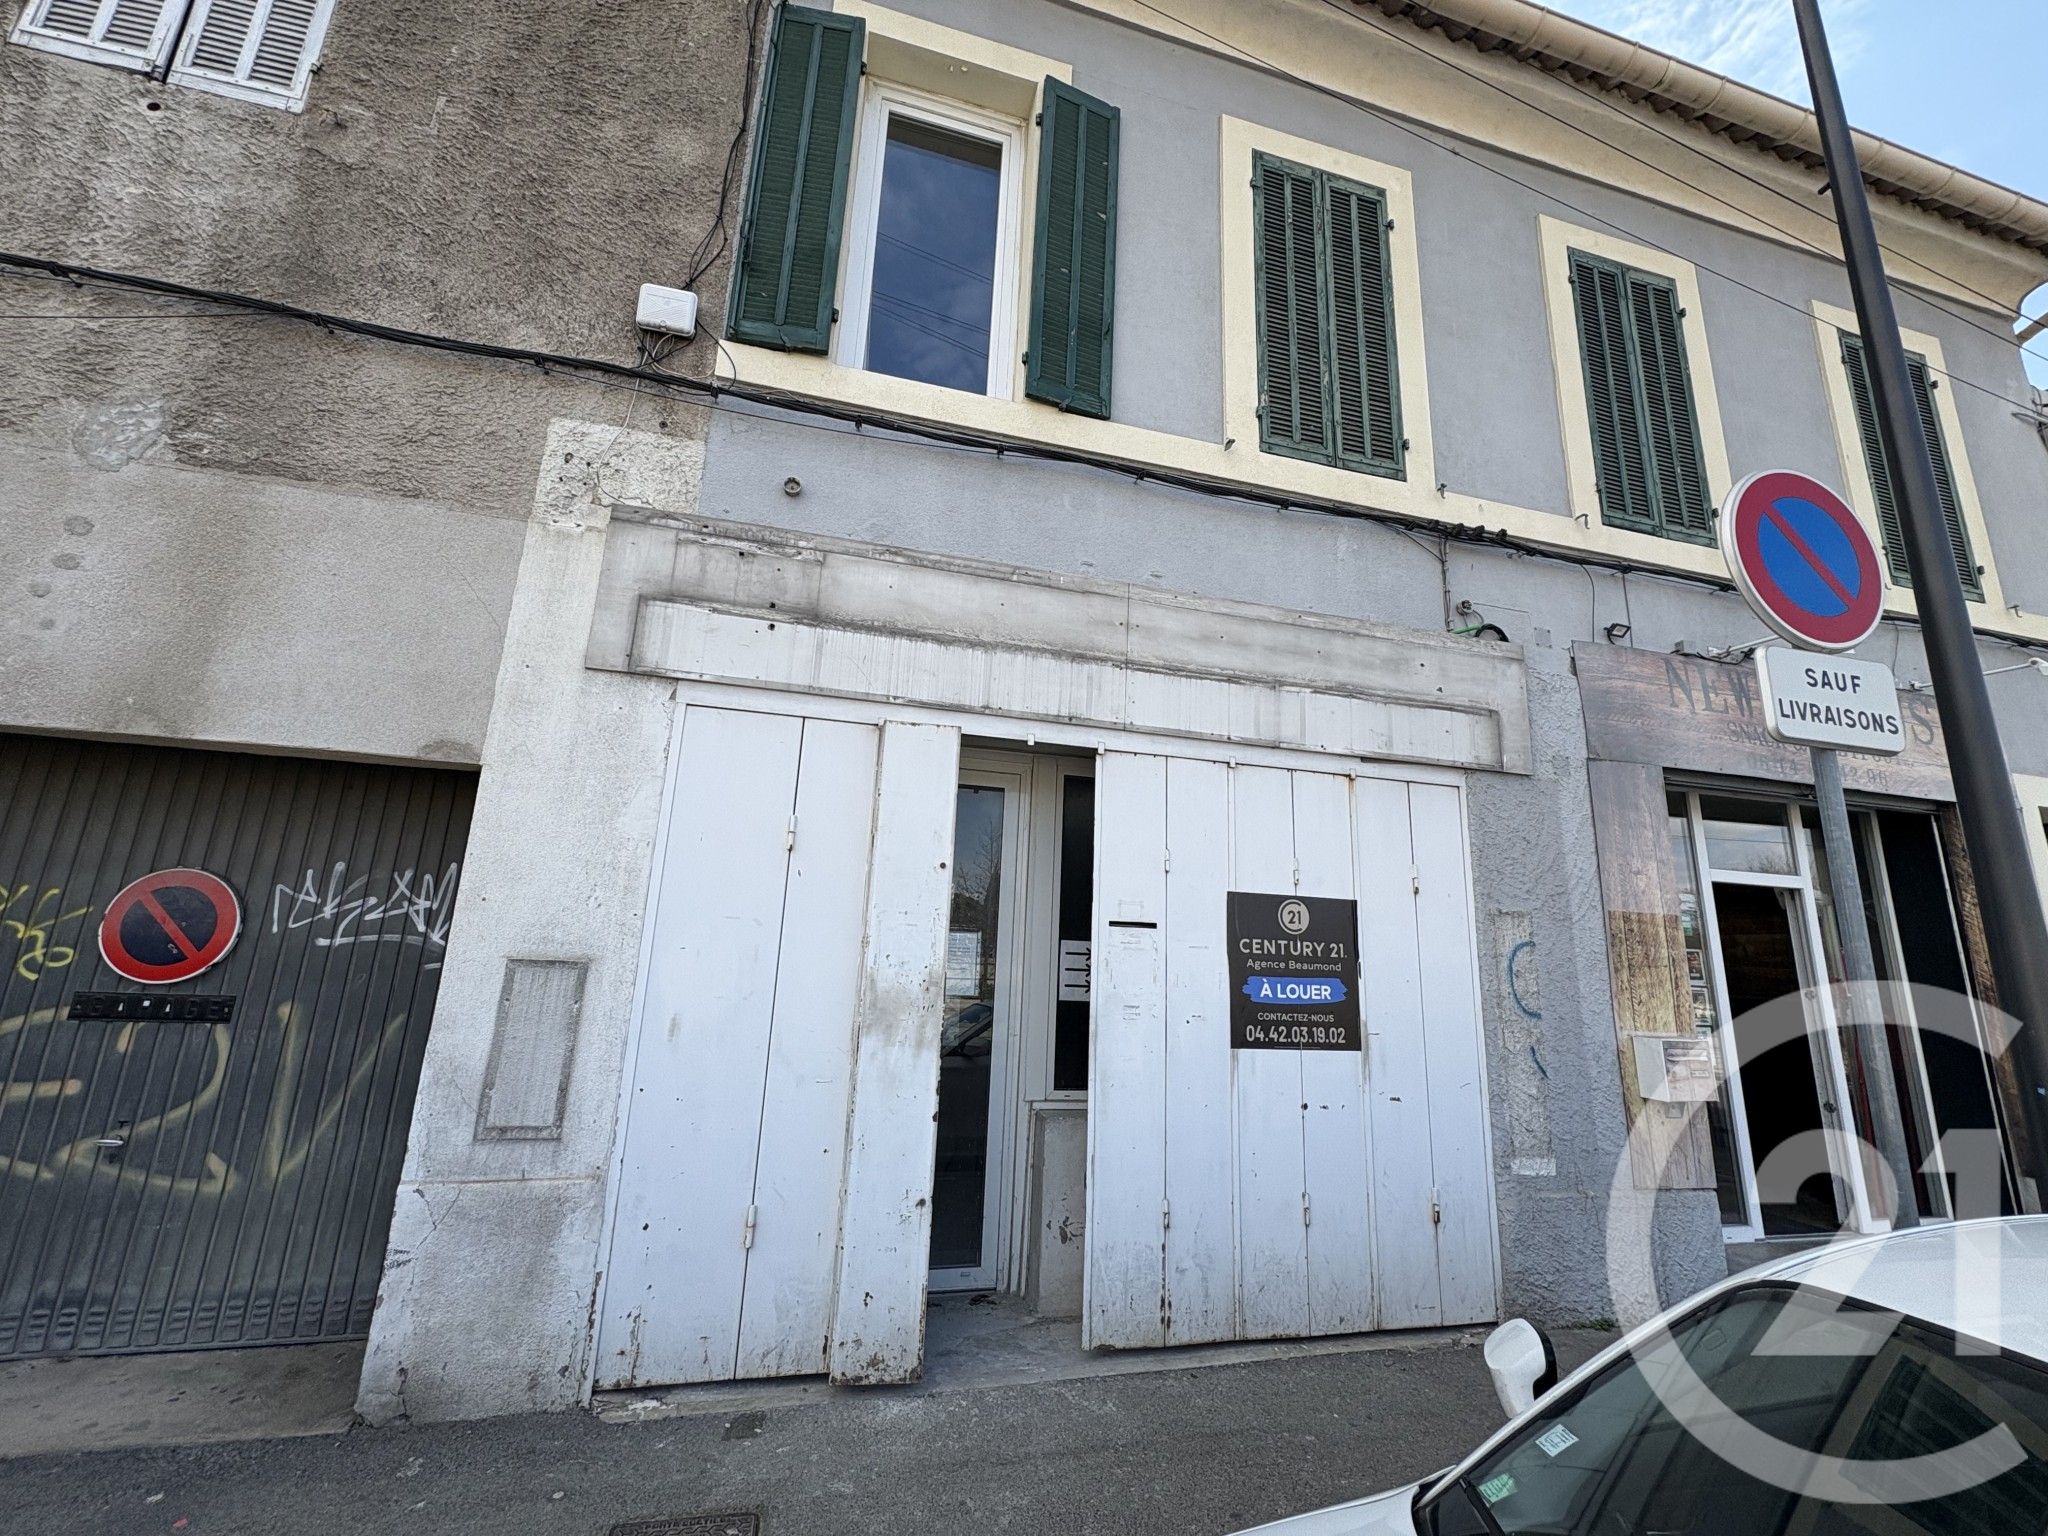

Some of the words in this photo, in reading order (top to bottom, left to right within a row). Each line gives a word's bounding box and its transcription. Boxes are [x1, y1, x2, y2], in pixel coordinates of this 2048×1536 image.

[1805, 667, 1861, 693] SAUF
[1778, 698, 1900, 736] LIVRAISONS
[1287, 910, 1302, 925] 21
[1239, 938, 1325, 957] CENTURY
[1246, 958, 1286, 971] Agence
[1288, 960, 1342, 972] Beaumond
[1260, 978, 1273, 998] À
[1277, 983, 1331, 1000] LOUER
[1257, 1012, 1335, 1023] CONTACTEZ-NOUS
[1246, 1024, 1346, 1044] 04.42.03.19.02
